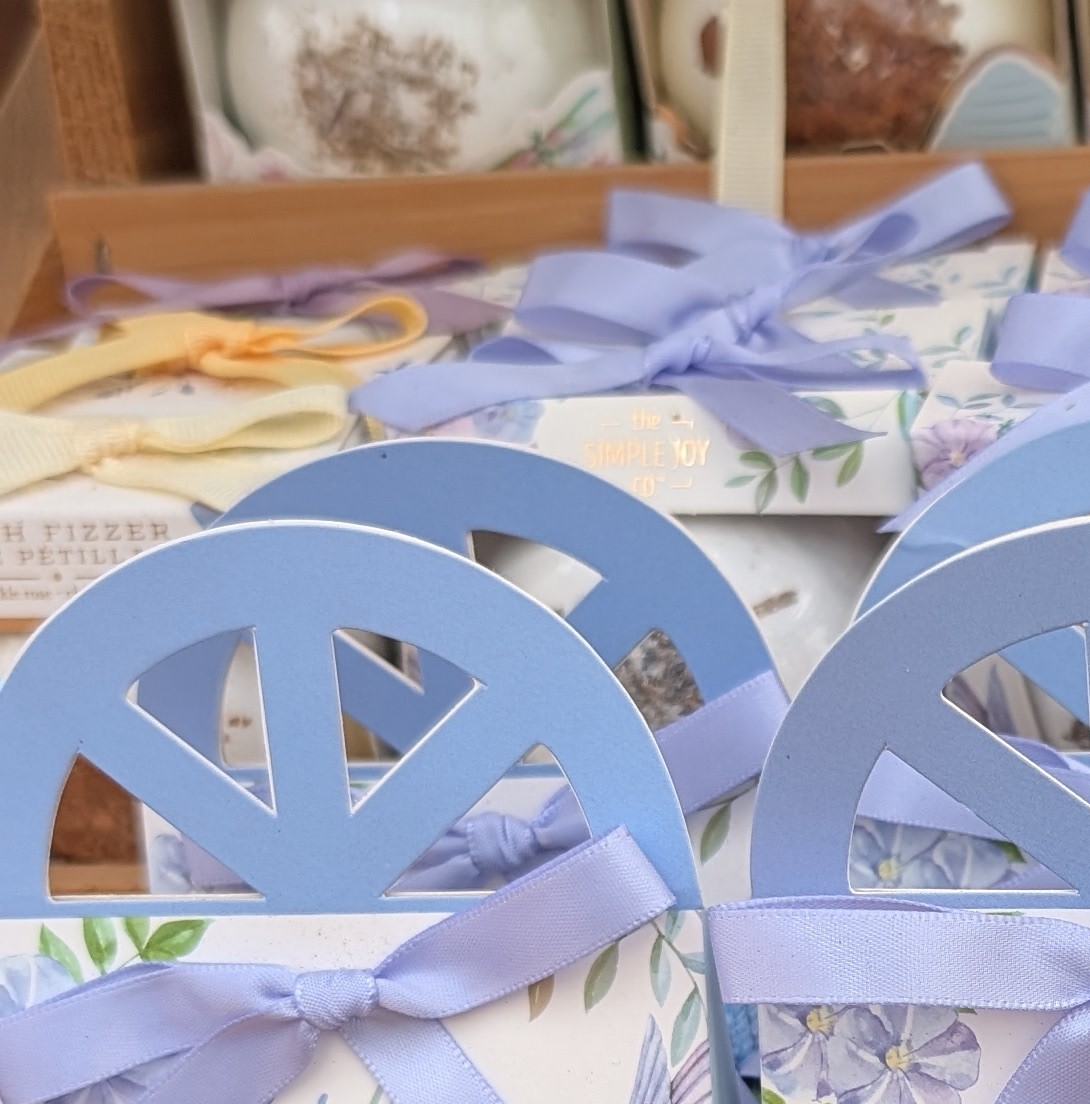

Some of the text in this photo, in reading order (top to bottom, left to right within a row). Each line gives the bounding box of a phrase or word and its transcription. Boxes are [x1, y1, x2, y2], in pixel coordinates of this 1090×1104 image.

[583, 437, 710, 471] SIMPLE JOY
[43, 519, 169, 543] FIZZER
